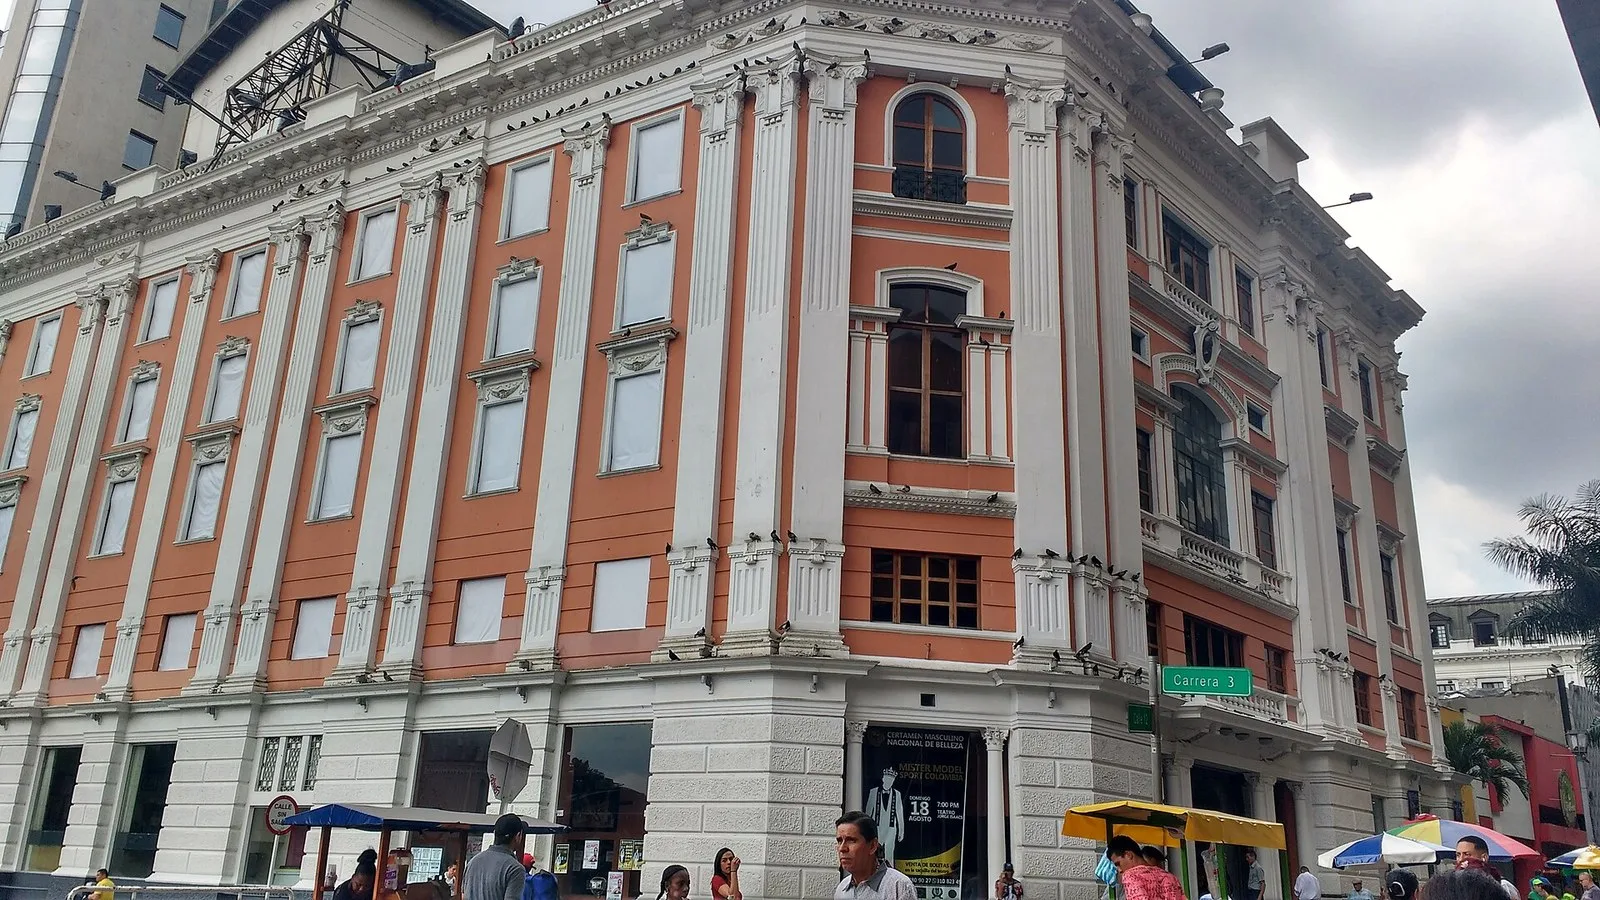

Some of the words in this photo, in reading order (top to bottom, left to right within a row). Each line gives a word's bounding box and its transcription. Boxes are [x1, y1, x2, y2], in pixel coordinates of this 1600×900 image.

[1173, 674, 1219, 688] Carrera
[1227, 676, 1235, 688] 3
[925, 734, 964, 742] MASCULINO
[887, 739, 924, 747] NACIONAL
[899, 763, 930, 772] MISTER
[932, 764, 964, 773] MODEL
[925, 772, 964, 781] COLOMBIA
[910, 801, 930, 816] 18
